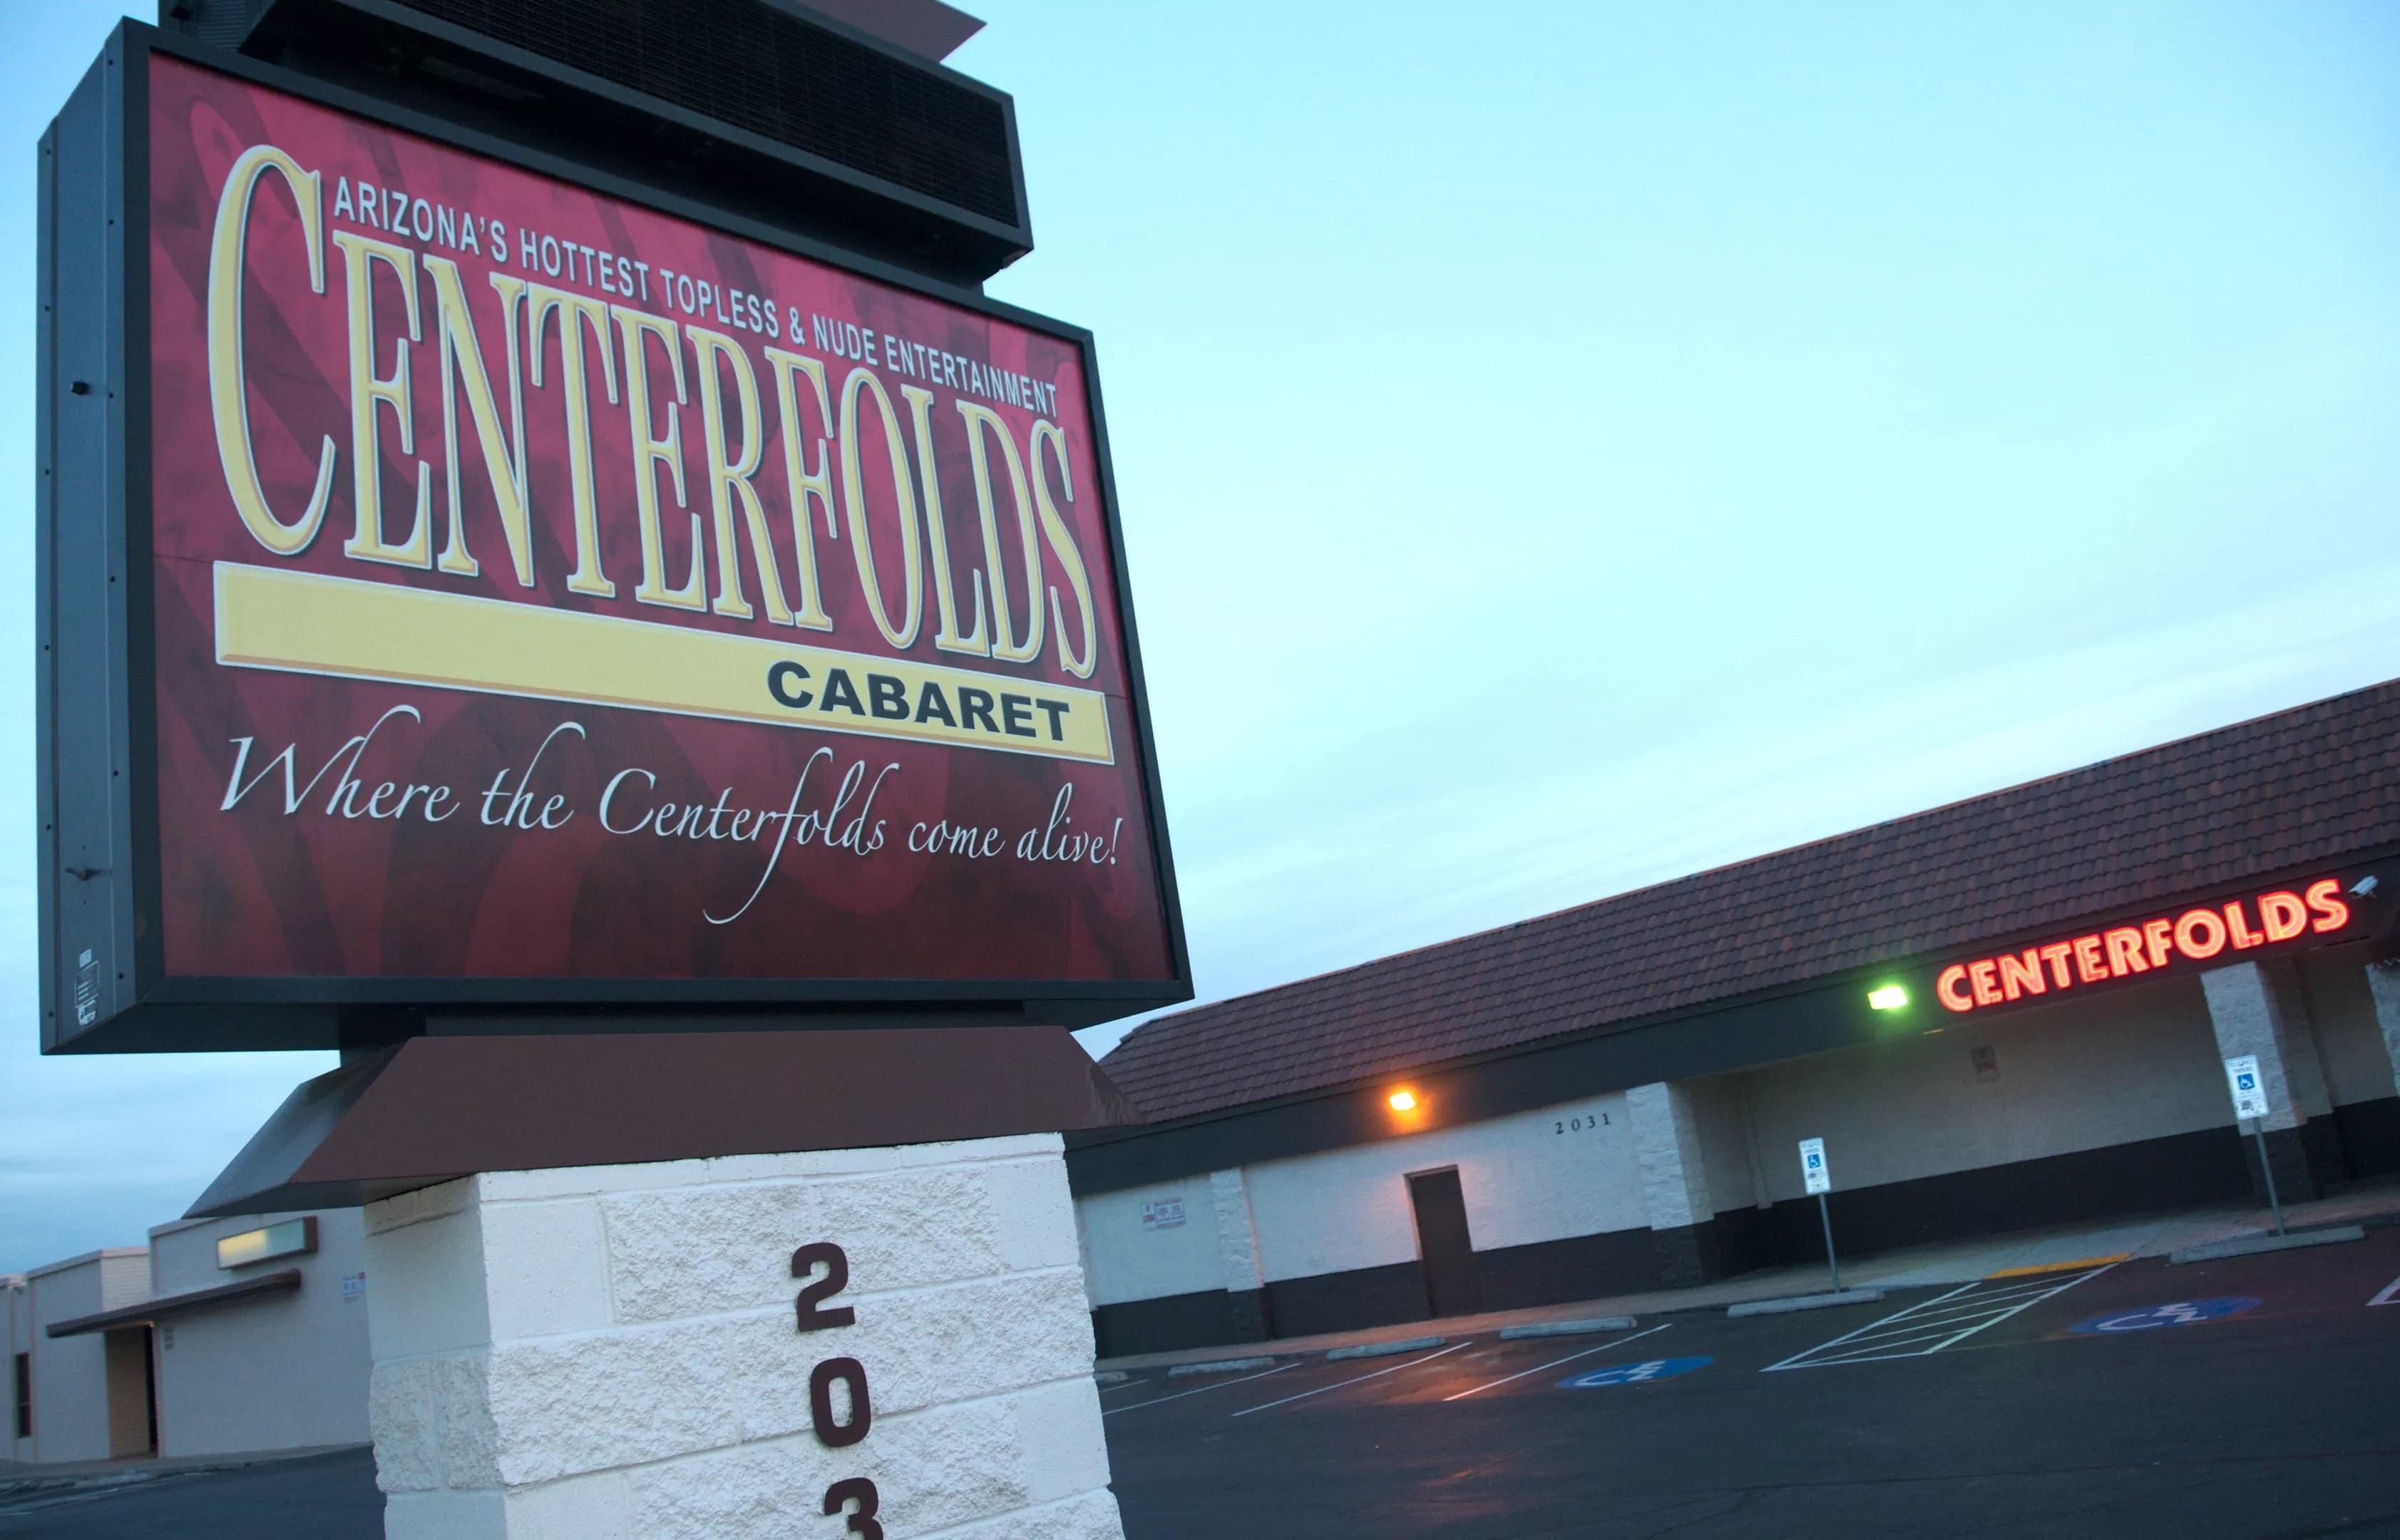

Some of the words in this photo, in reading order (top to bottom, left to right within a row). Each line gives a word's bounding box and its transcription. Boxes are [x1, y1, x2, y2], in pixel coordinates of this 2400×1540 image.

[333, 175, 508, 262] ARIZONA'S
[519, 228, 650, 301] HOTTEST
[660, 268, 779, 339] TOPLESS
[789, 307, 806, 346] &
[812, 313, 878, 366] NUDE
[886, 336, 1057, 417] ENTERTAINMENT
[207, 144, 1097, 679] CENTERFOLDS
[766, 660, 1070, 742] CABARET
[220, 704, 461, 822] Where
[481, 722, 586, 829] the
[599, 747, 900, 925] Centerfolds
[908, 819, 1005, 858] come
[1016, 782, 1124, 864] alive!
[1936, 878, 2351, 1012] CENTERFOLDS
[1555, 1112, 1611, 1134] 2031
